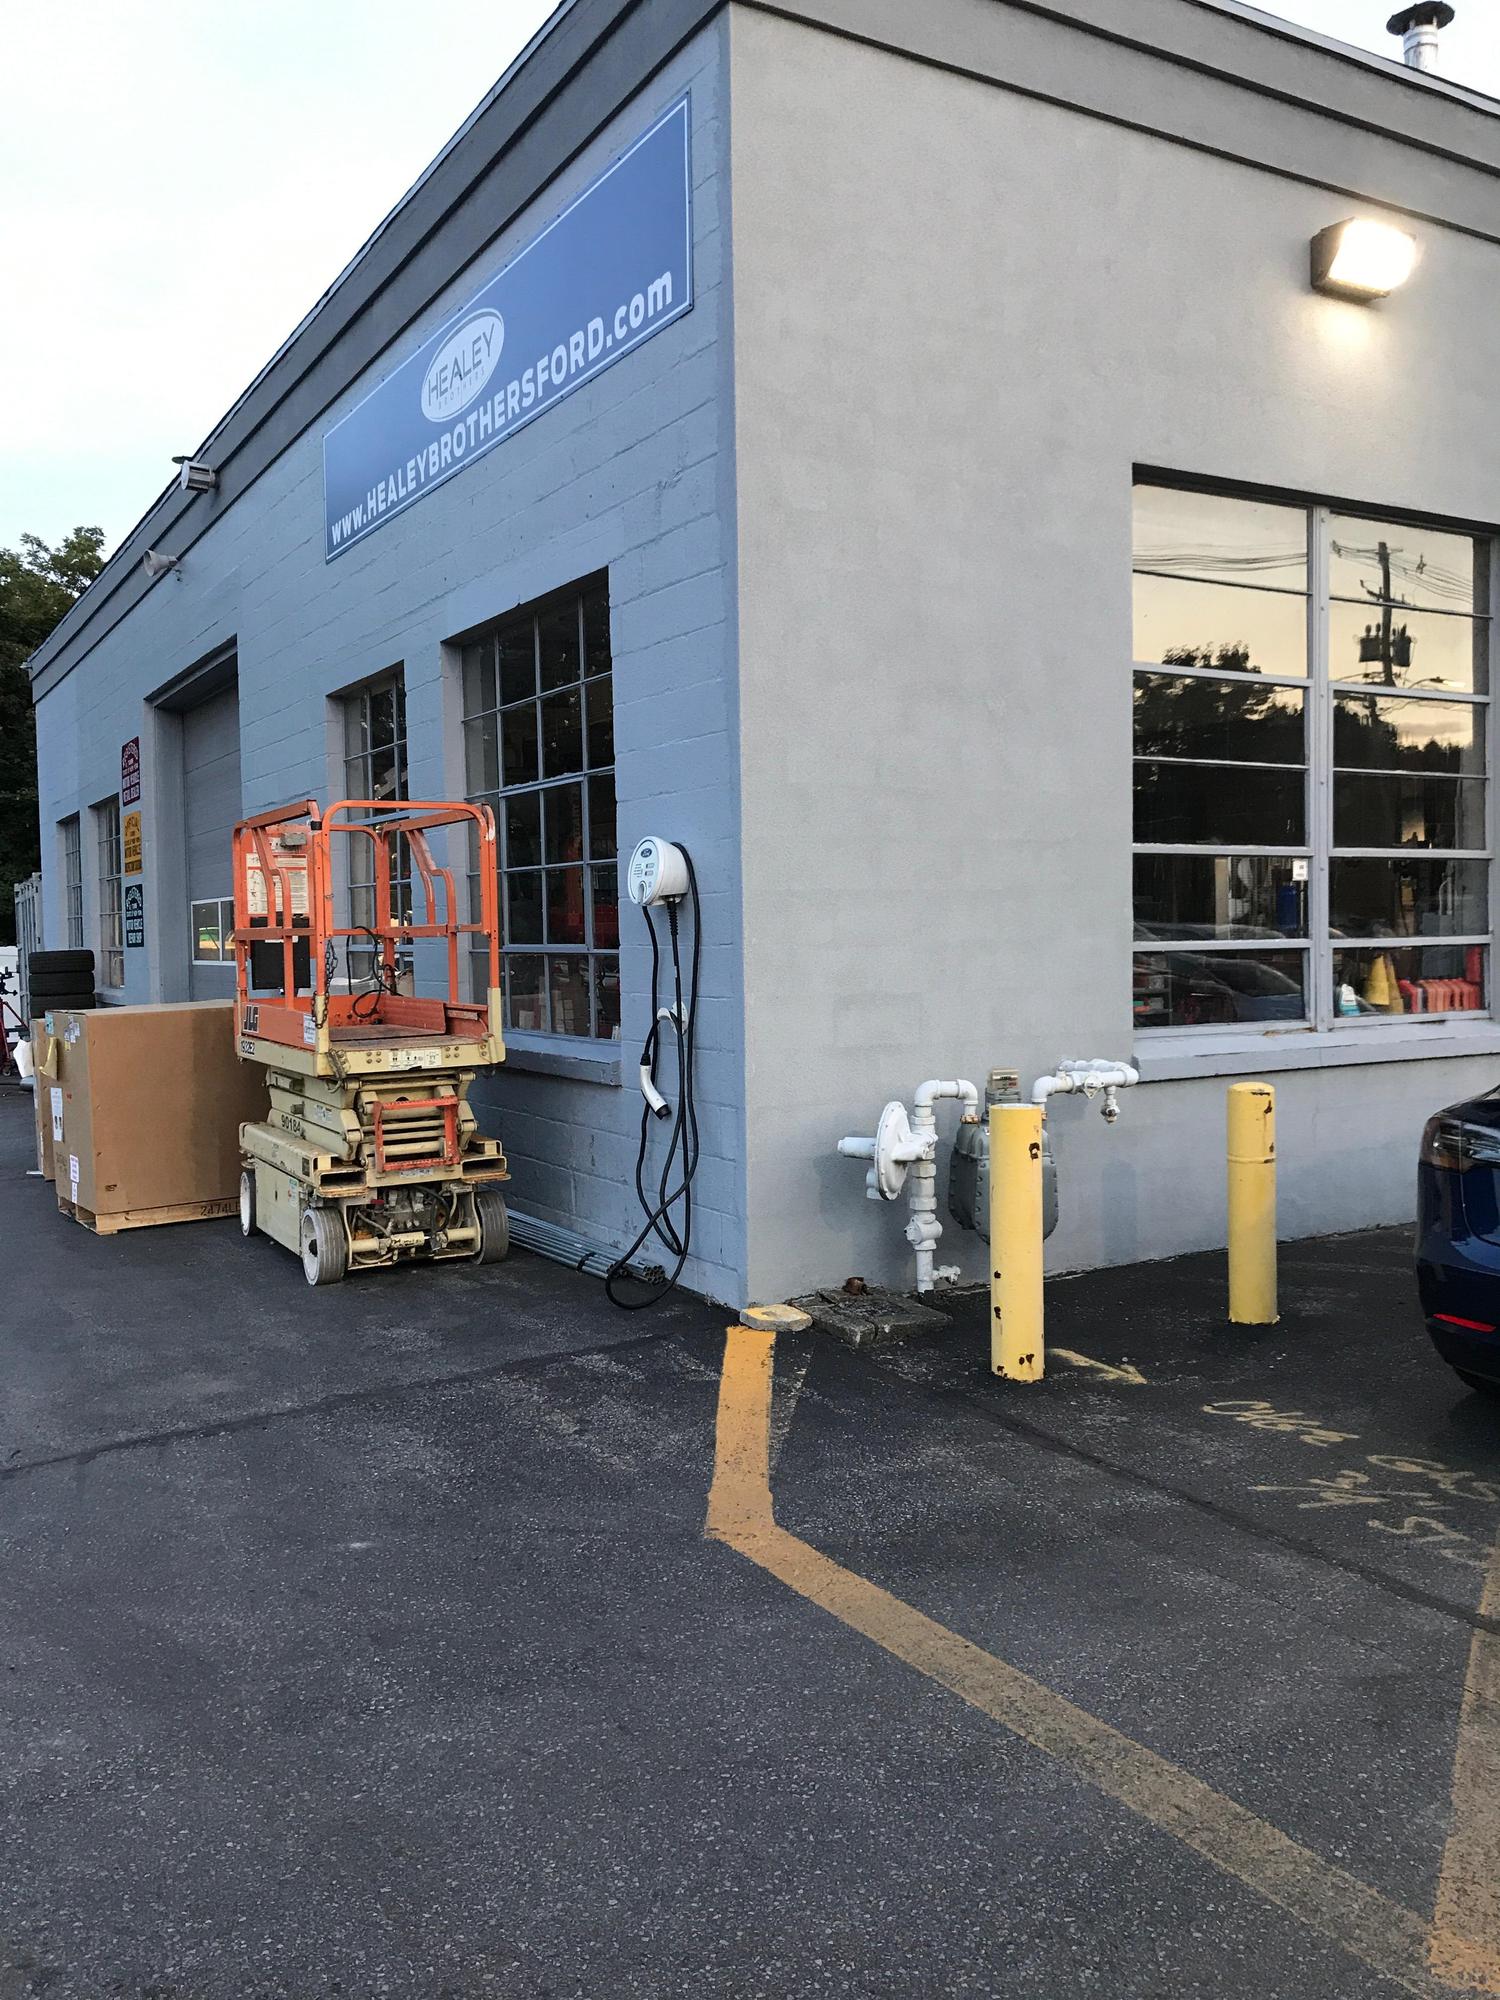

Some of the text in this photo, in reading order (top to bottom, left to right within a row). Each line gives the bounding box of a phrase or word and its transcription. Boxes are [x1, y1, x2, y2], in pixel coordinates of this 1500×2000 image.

[428, 322, 495, 407] HEALEY
[331, 269, 673, 546] www.HEALEYBROTHERSFORD.com
[243, 1005, 260, 1033] JLG
[281, 1114, 301, 1133] 90184
